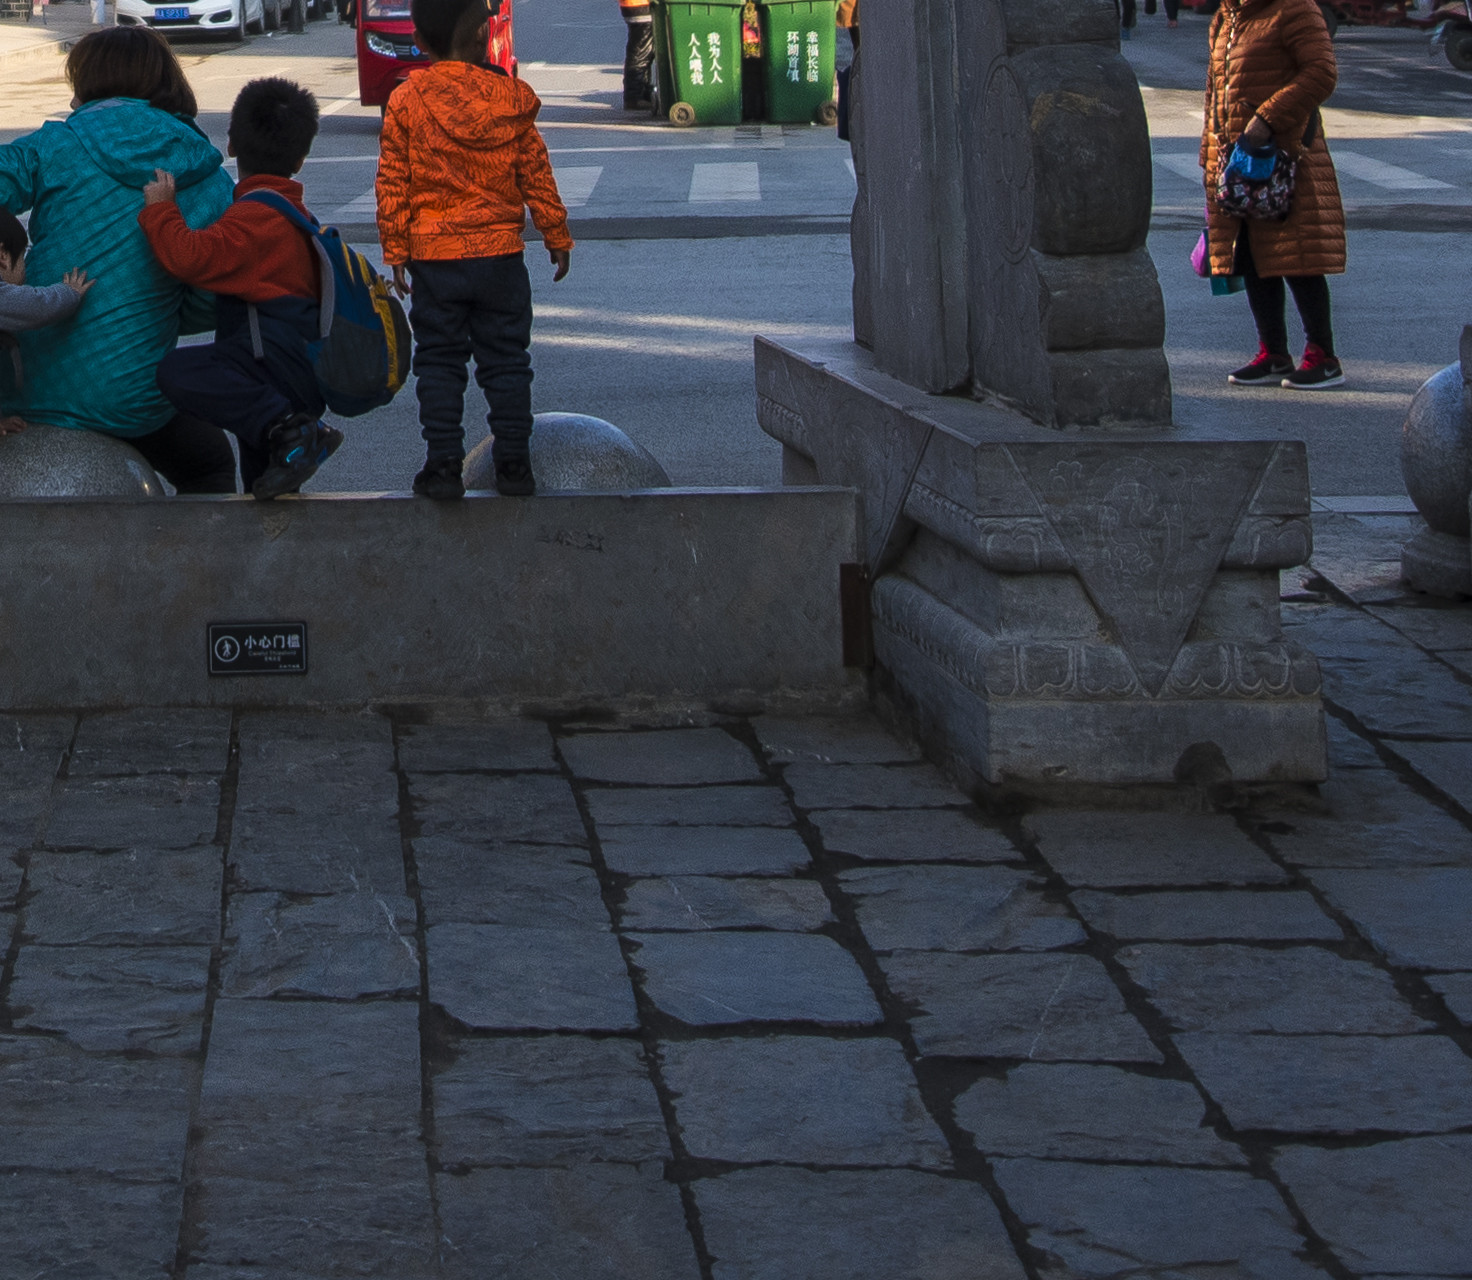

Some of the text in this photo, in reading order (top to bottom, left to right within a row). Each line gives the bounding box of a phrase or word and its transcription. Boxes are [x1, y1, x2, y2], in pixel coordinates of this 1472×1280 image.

[707, 32, 724, 84] 我为人人
[786, 31, 800, 83] 环湖首镇
[806, 31, 820, 83] 幸福长临
[244, 634, 301, 649] 小心门槛
